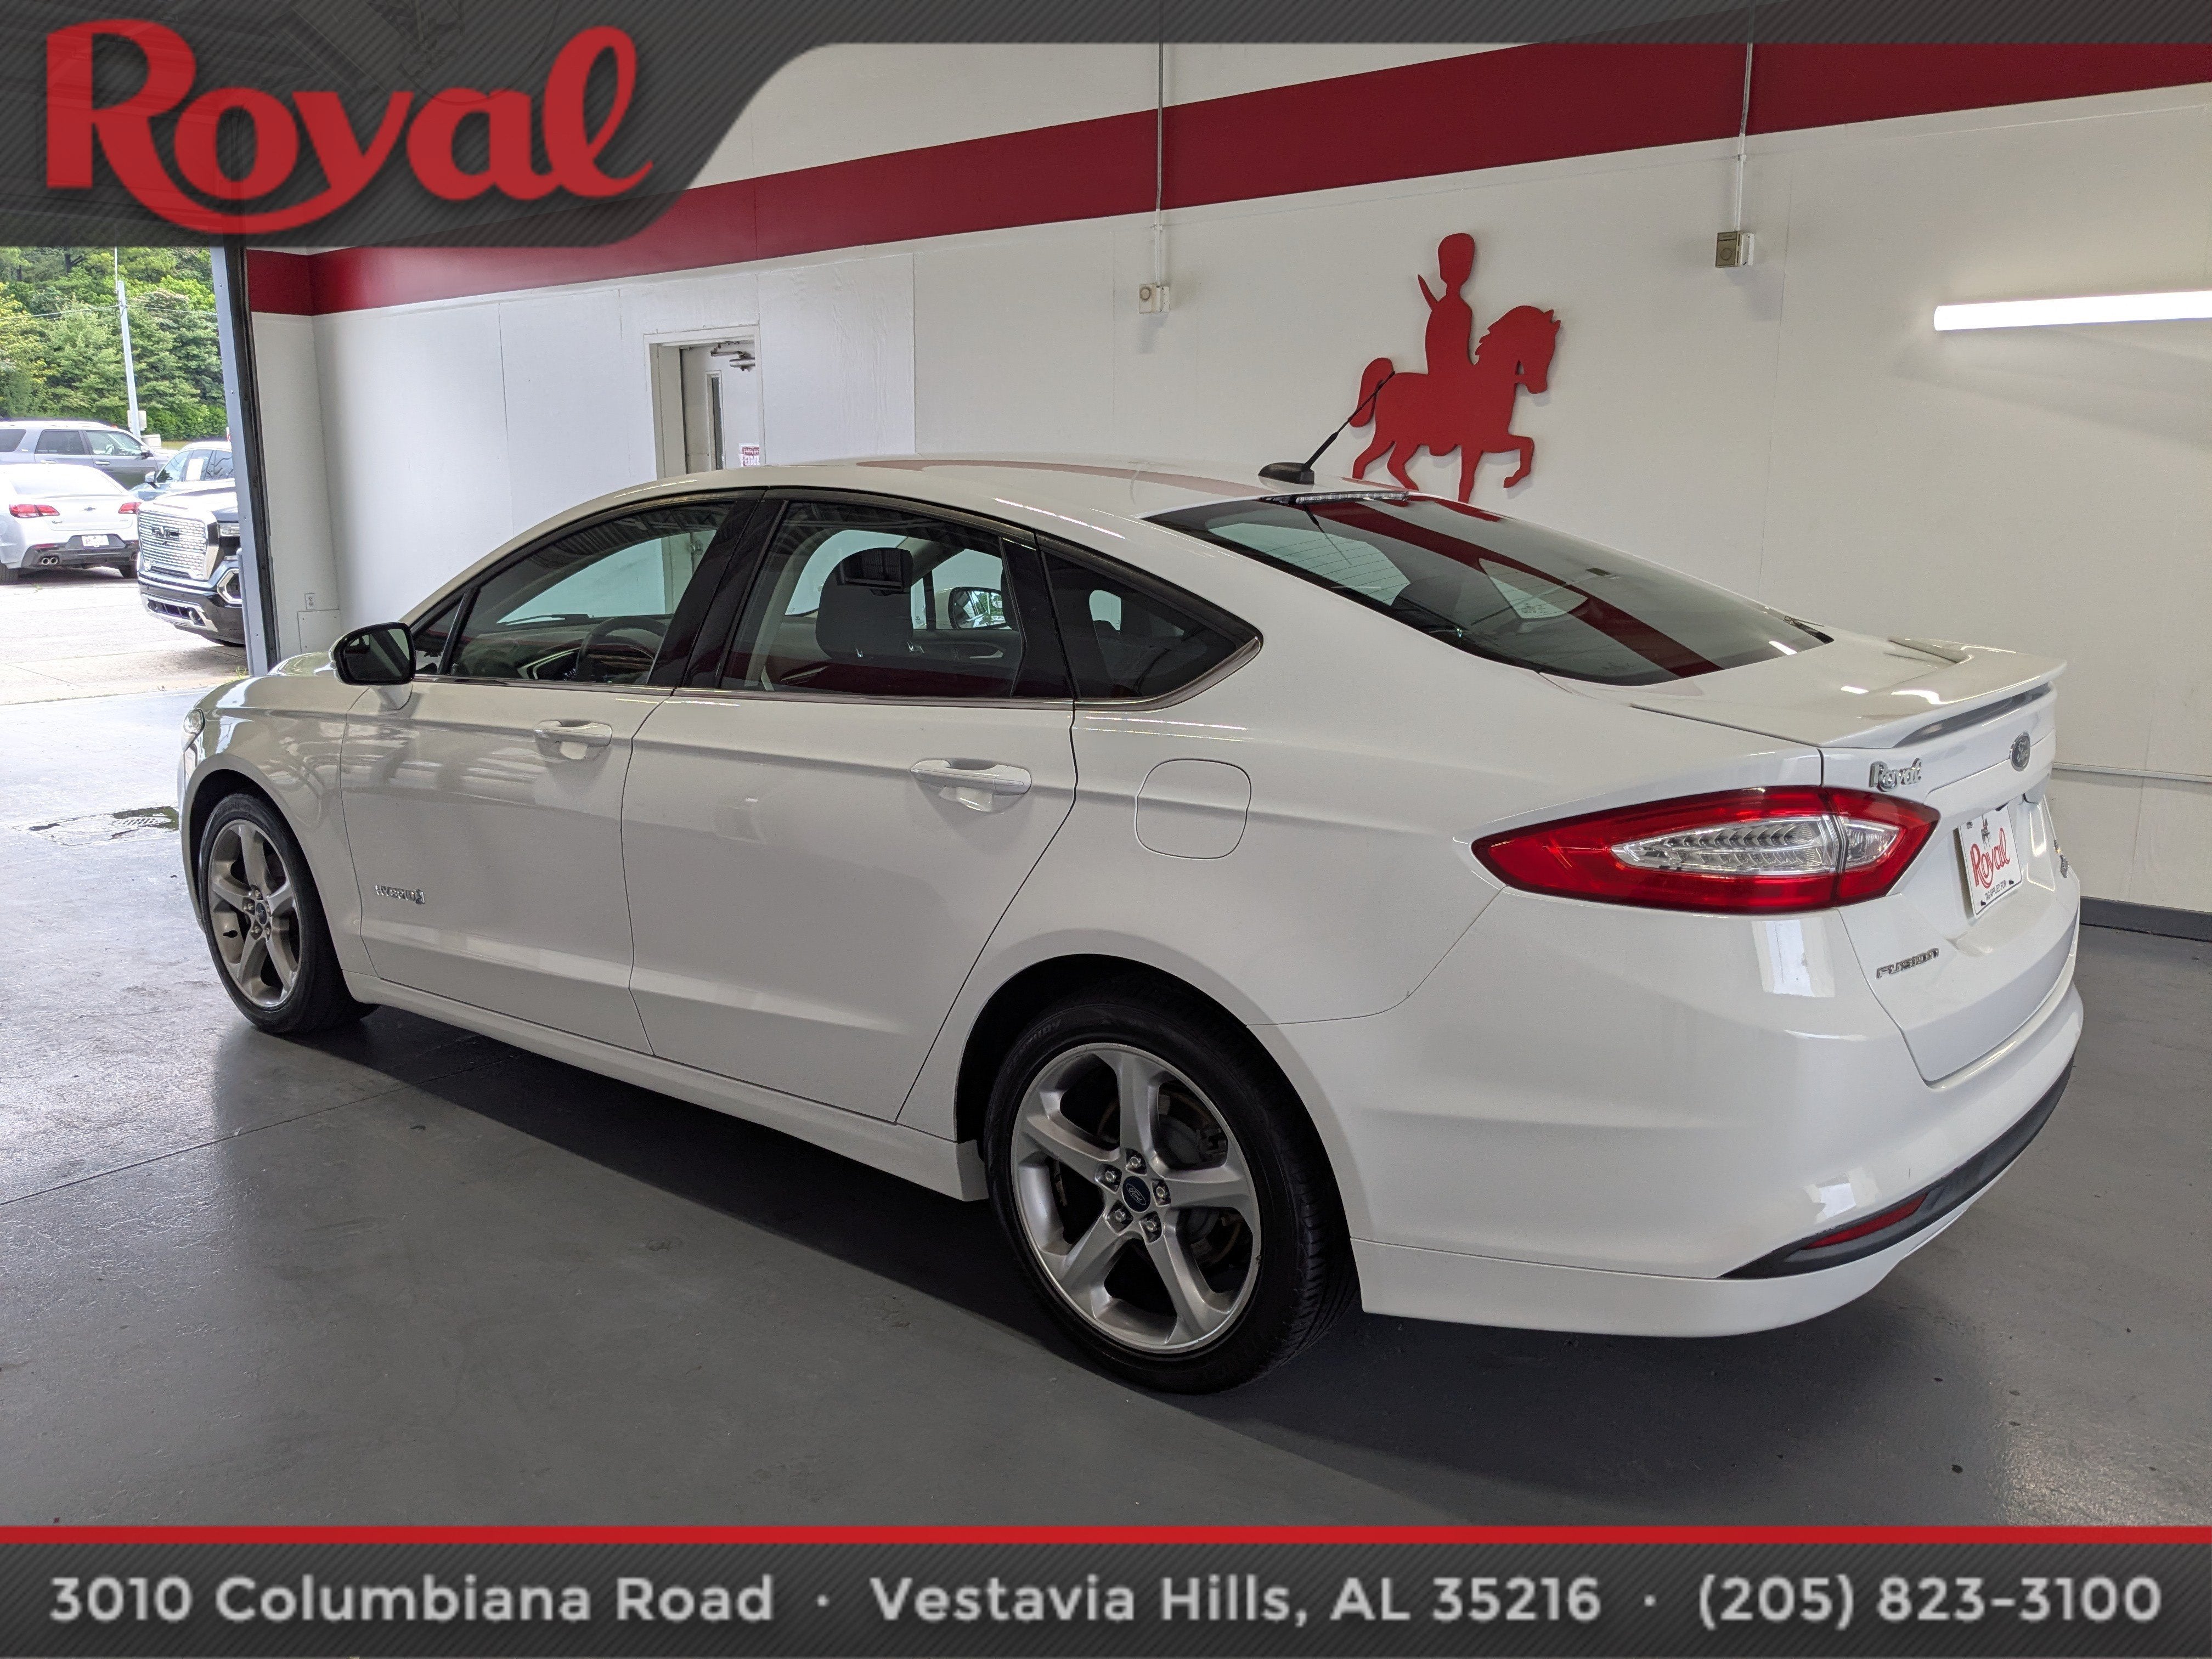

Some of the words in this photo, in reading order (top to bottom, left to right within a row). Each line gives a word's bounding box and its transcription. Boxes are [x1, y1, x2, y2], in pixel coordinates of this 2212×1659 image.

[152, 525, 180, 541] GMC
[1869, 758, 1922, 792] Royal
[1970, 827, 2011, 889] Royal
[1876, 947, 1939, 979] FUSION
